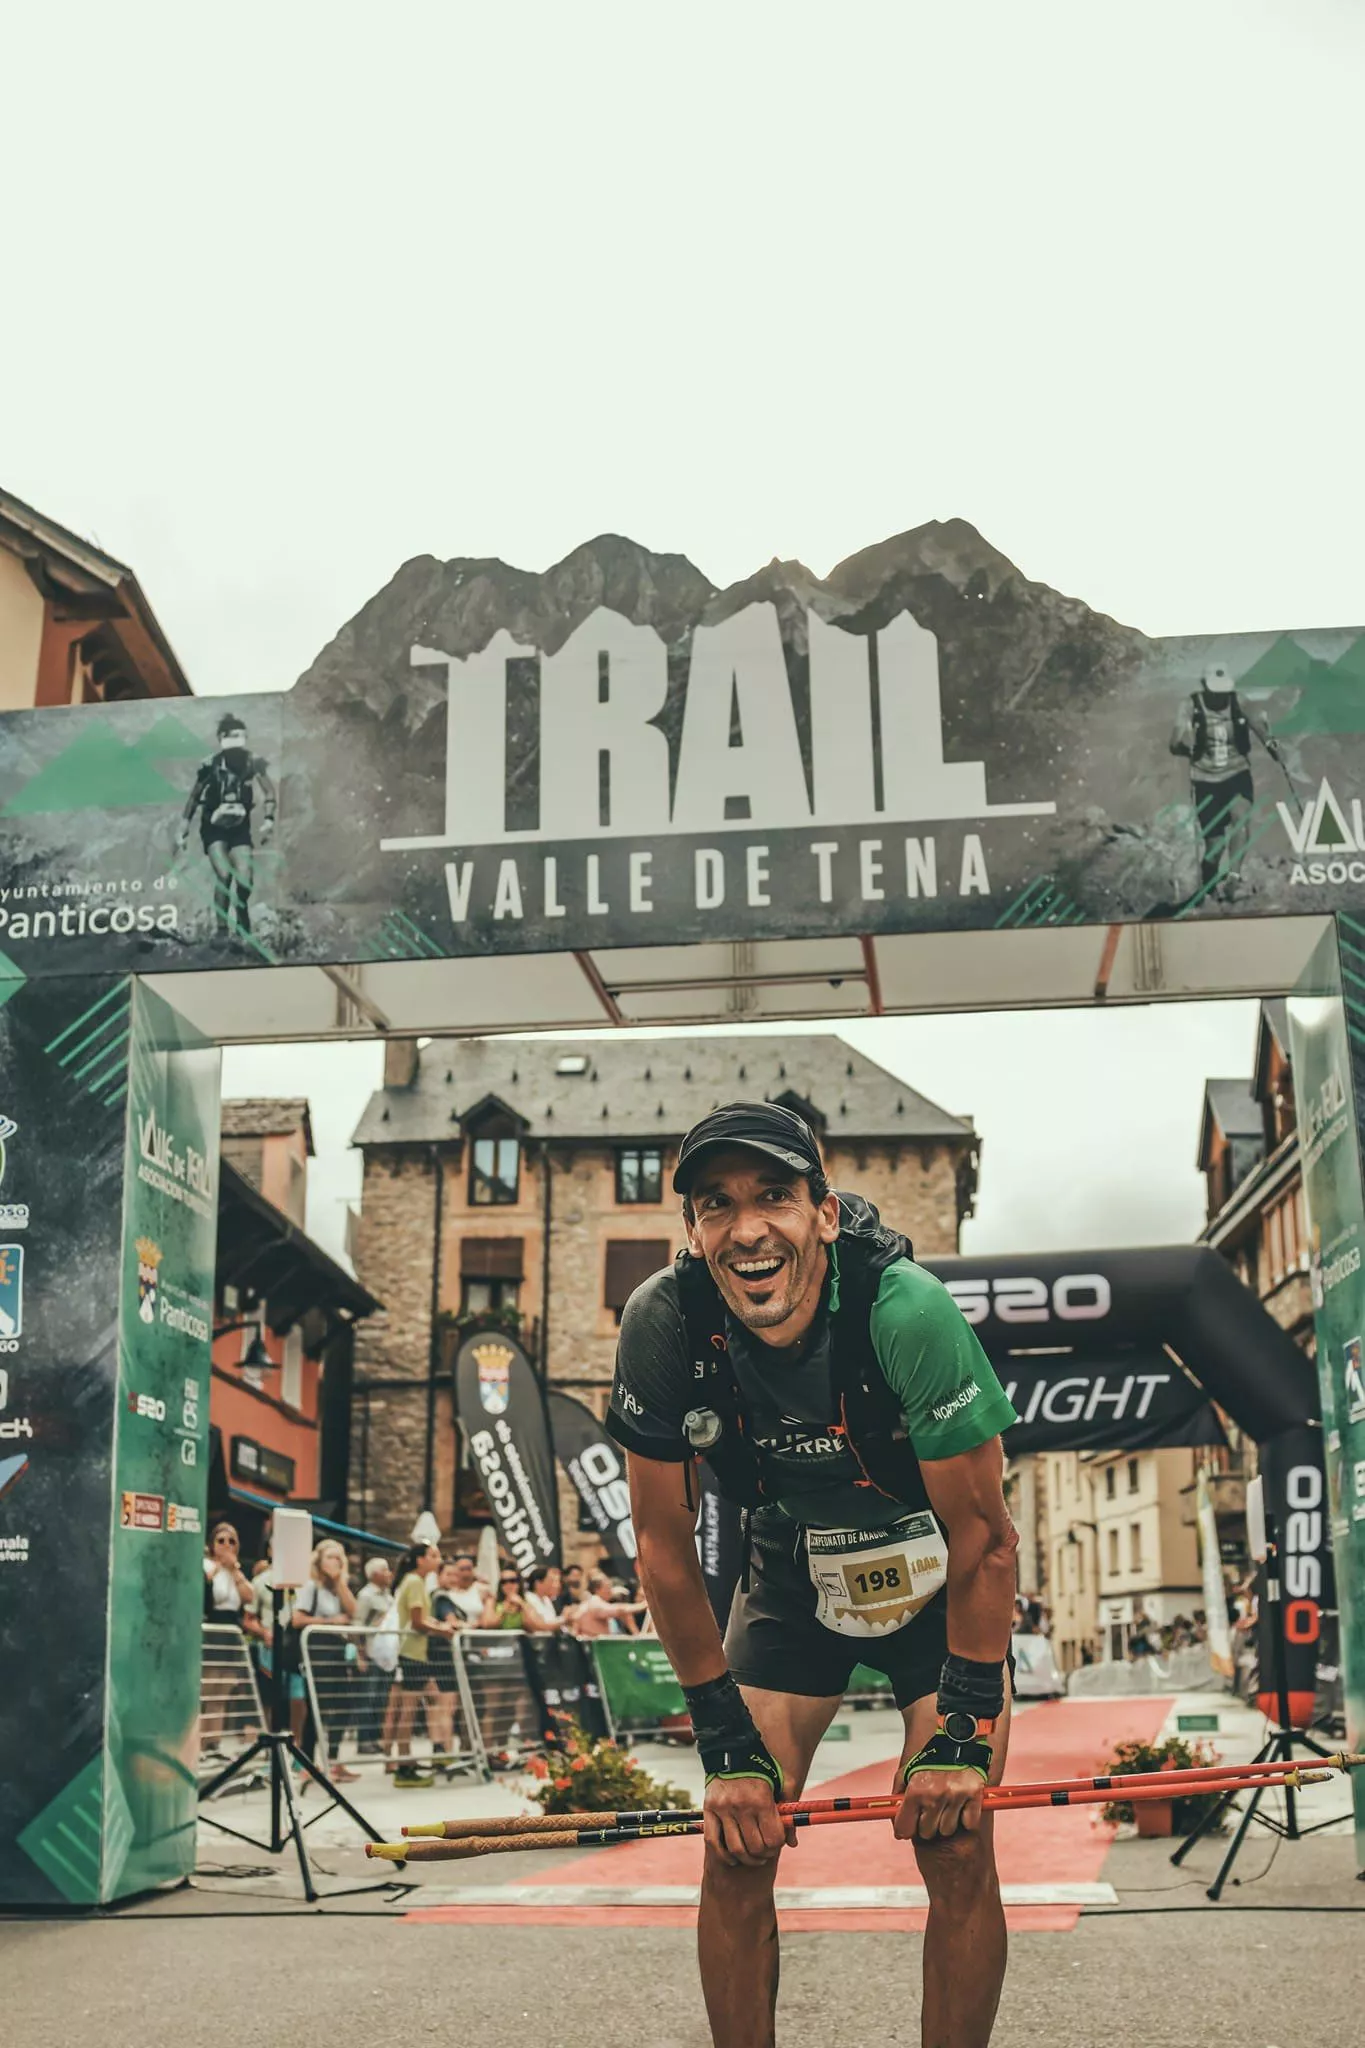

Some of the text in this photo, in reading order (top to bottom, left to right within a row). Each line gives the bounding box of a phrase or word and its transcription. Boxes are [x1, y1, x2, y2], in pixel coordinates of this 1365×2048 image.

[410, 600, 988, 838] TRAIL
[153, 875, 179, 890] de
[445, 835, 990, 923] VALLE DE TENA
[847, 1532, 858, 1545] DE
[854, 1566, 901, 1594] 198
[638, 1823, 688, 1837] LEKI
